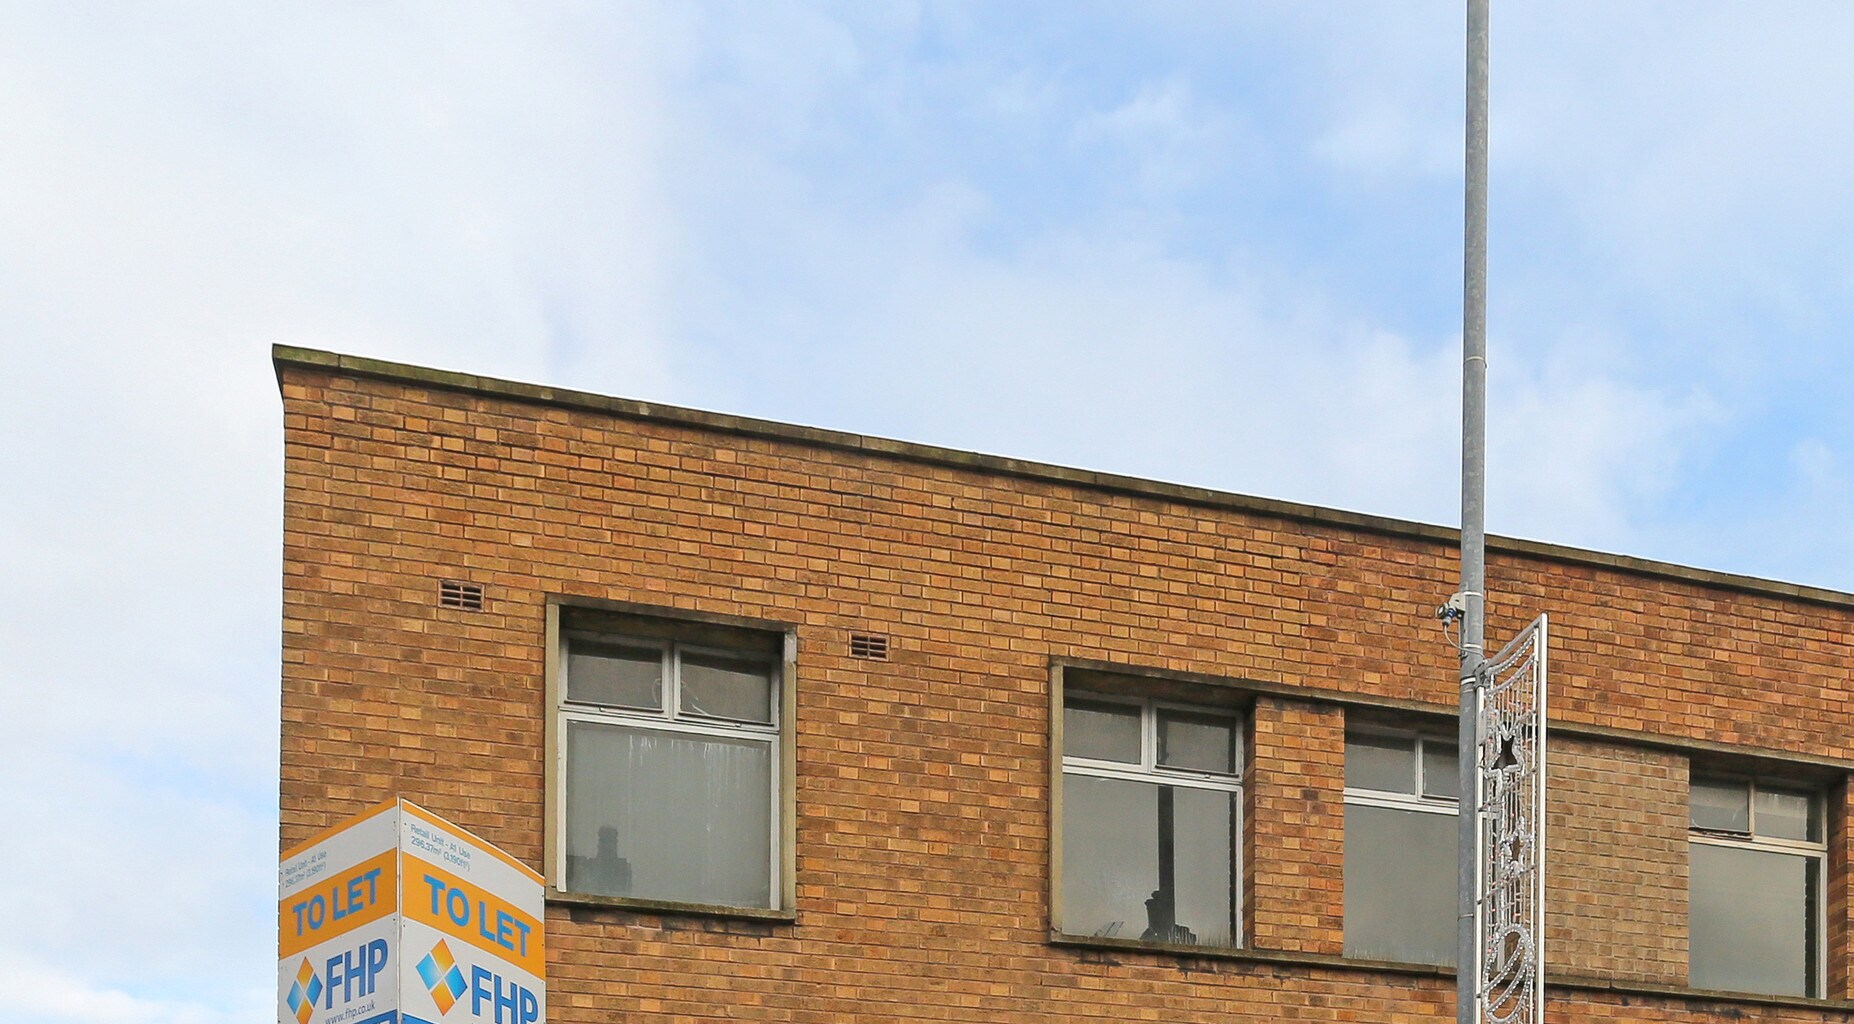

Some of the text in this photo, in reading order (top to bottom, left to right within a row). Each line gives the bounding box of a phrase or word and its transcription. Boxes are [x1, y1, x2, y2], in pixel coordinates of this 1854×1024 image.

[292, 895, 326, 936] TO
[332, 867, 382, 921] LET
[423, 873, 531, 958] TO LET
[326, 938, 388, 1010] FHP
